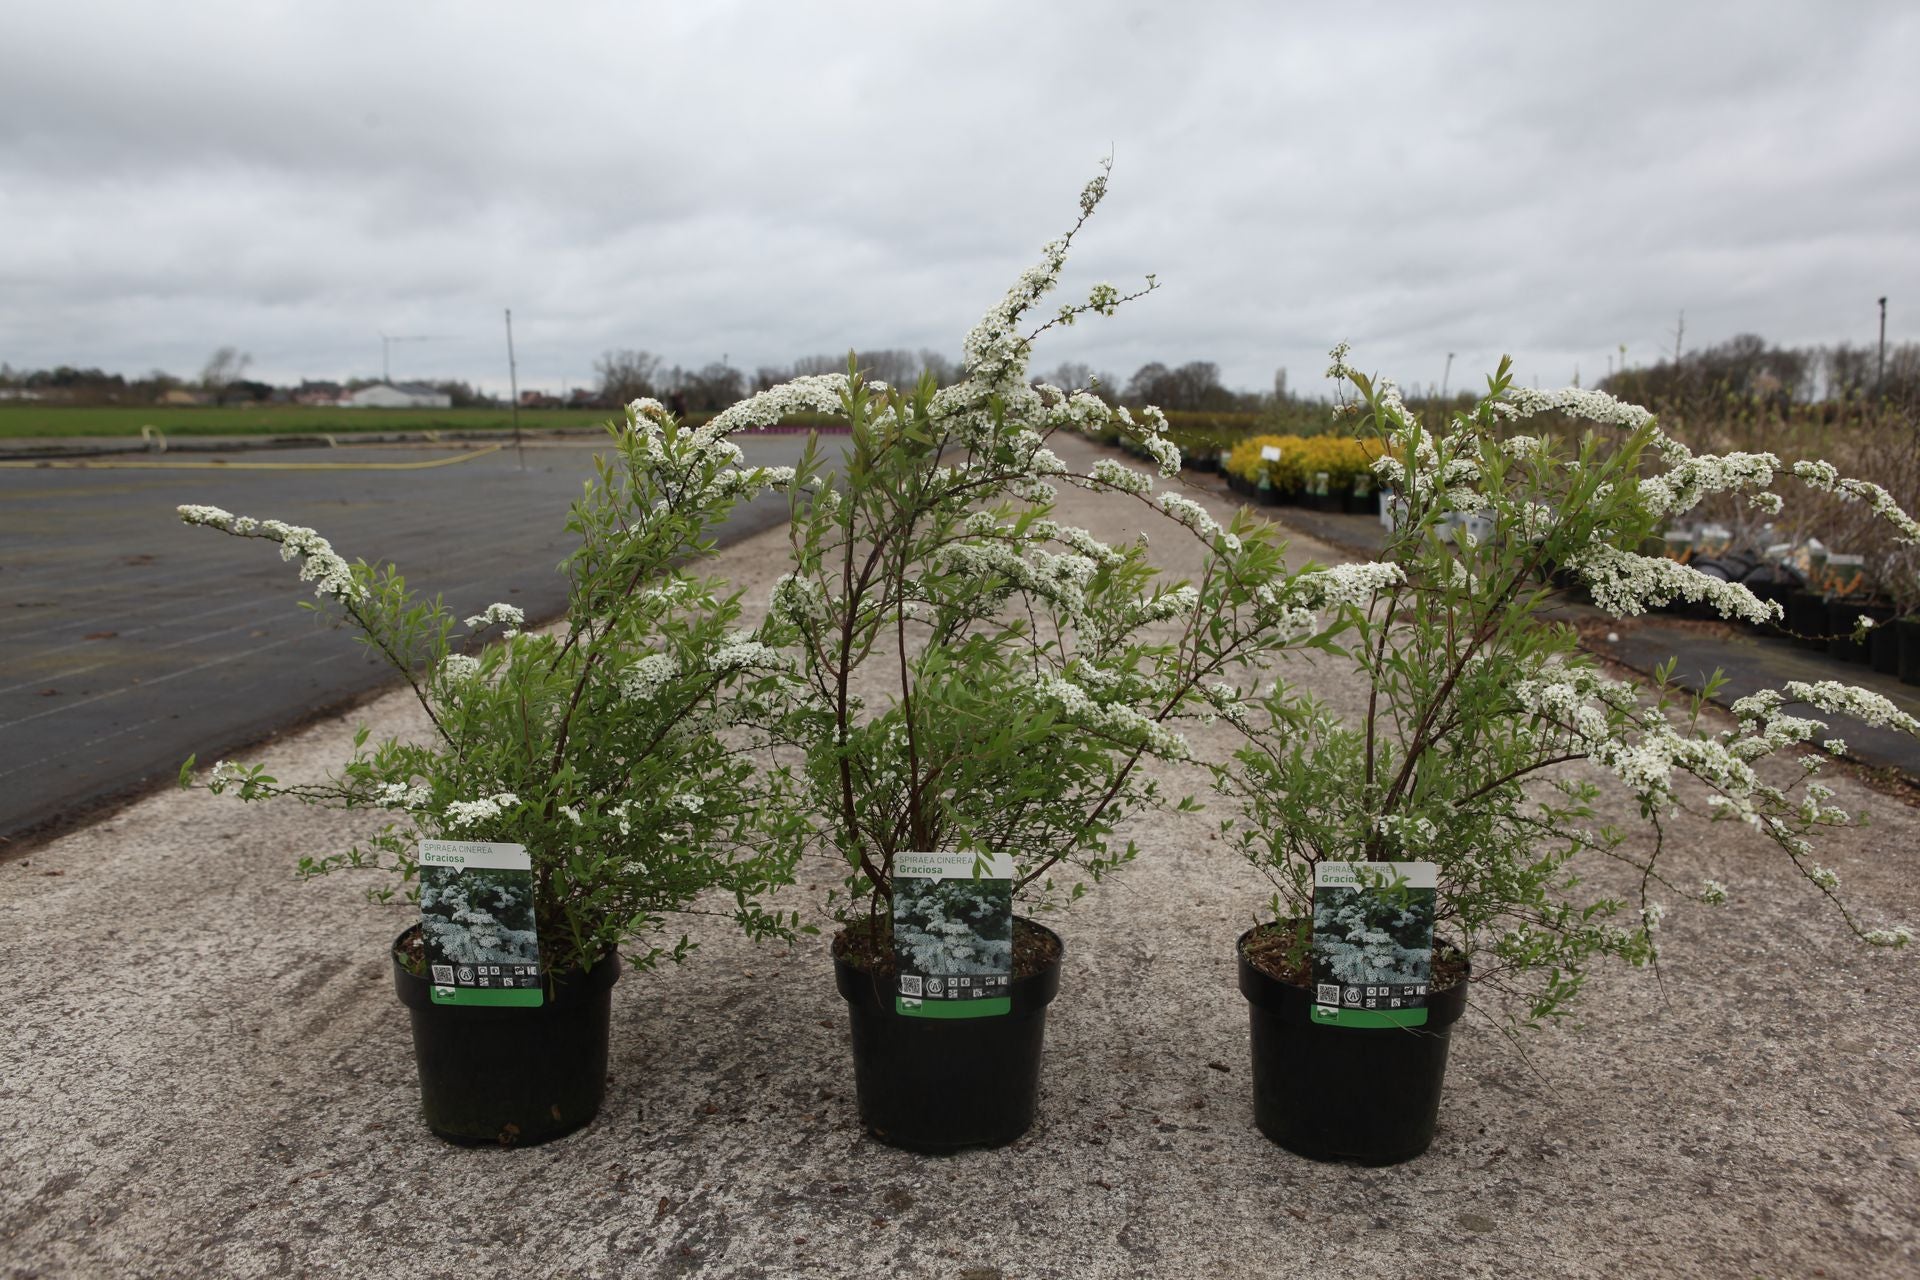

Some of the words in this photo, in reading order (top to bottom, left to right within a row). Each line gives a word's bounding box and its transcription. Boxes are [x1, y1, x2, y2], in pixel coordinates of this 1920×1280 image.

[424, 843, 457, 852] SPIRAEA
[459, 845, 493, 854] CINEREA
[424, 852, 465, 863] Graciosa
[899, 856, 935, 864] SPIRAEA
[937, 856, 974, 864] CINEREA
[899, 865, 943, 874] Graciosa
